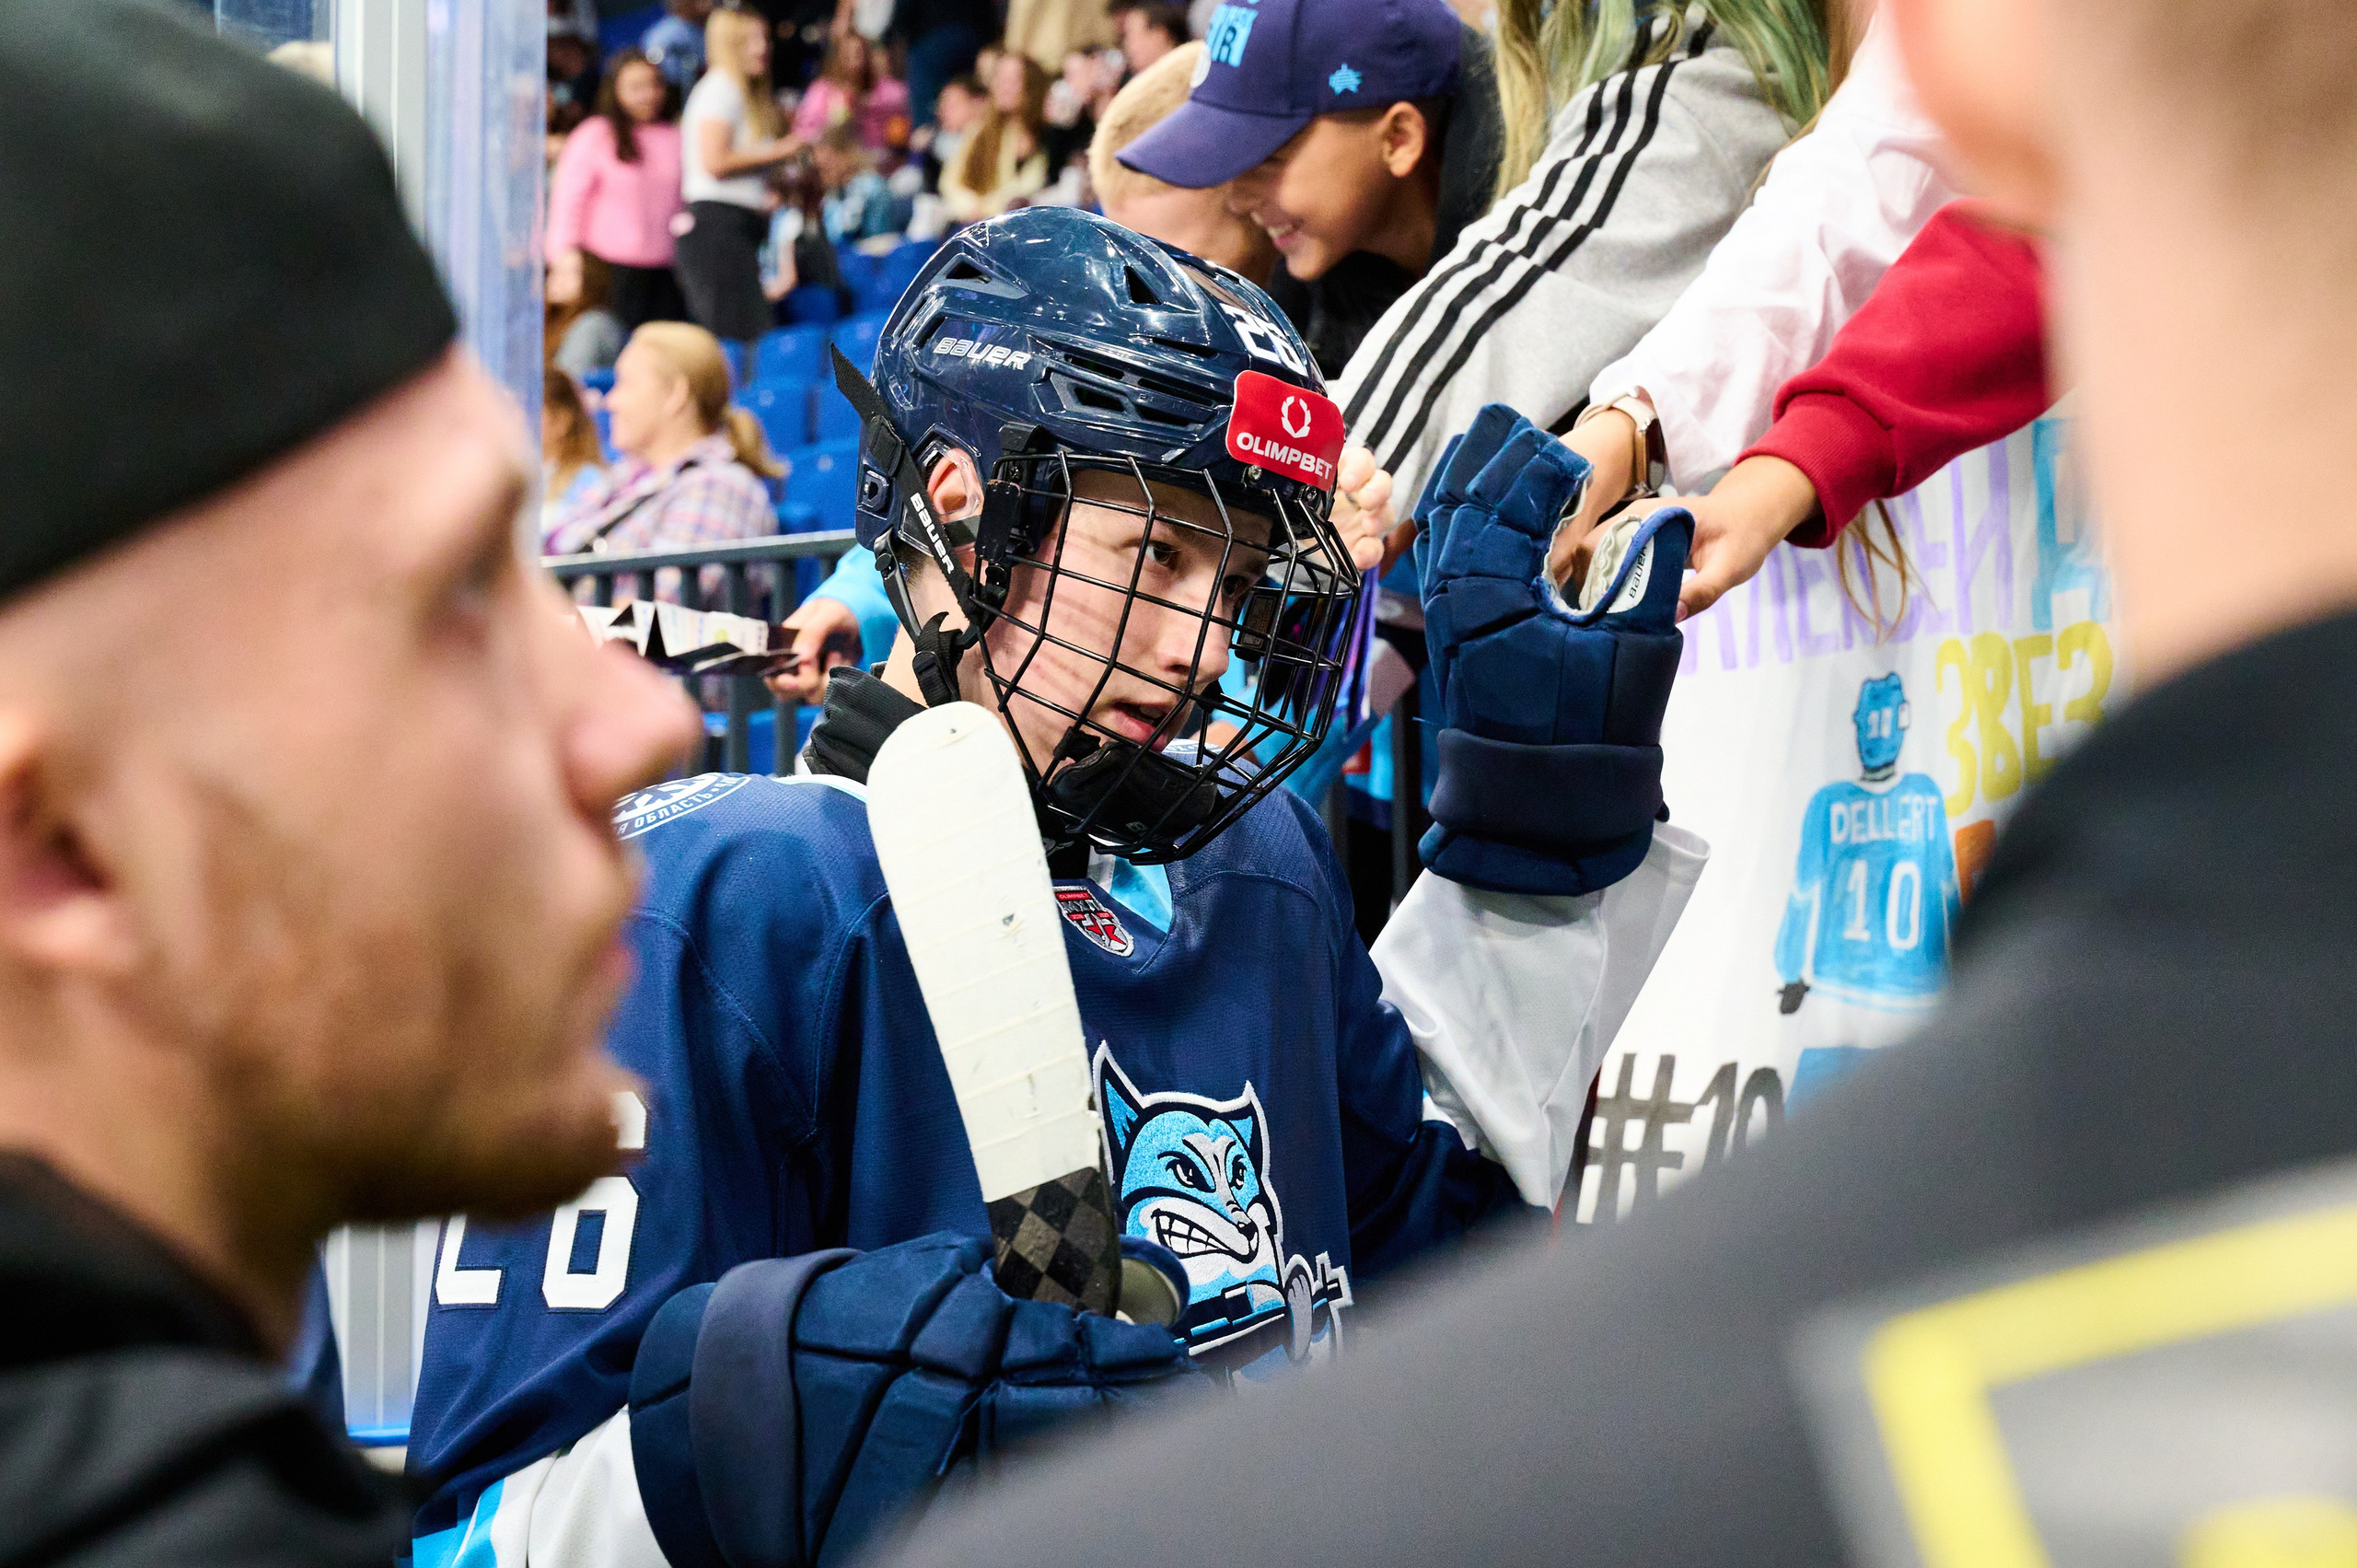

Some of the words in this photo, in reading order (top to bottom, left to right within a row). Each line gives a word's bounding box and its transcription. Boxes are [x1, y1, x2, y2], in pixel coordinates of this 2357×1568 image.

[1237, 432, 1332, 480] OLIMPBET
[634, 791, 714, 829] ОБЛАСТЬ
[1830, 796, 1939, 845] DELLERT
[1843, 858, 1922, 949] 10
